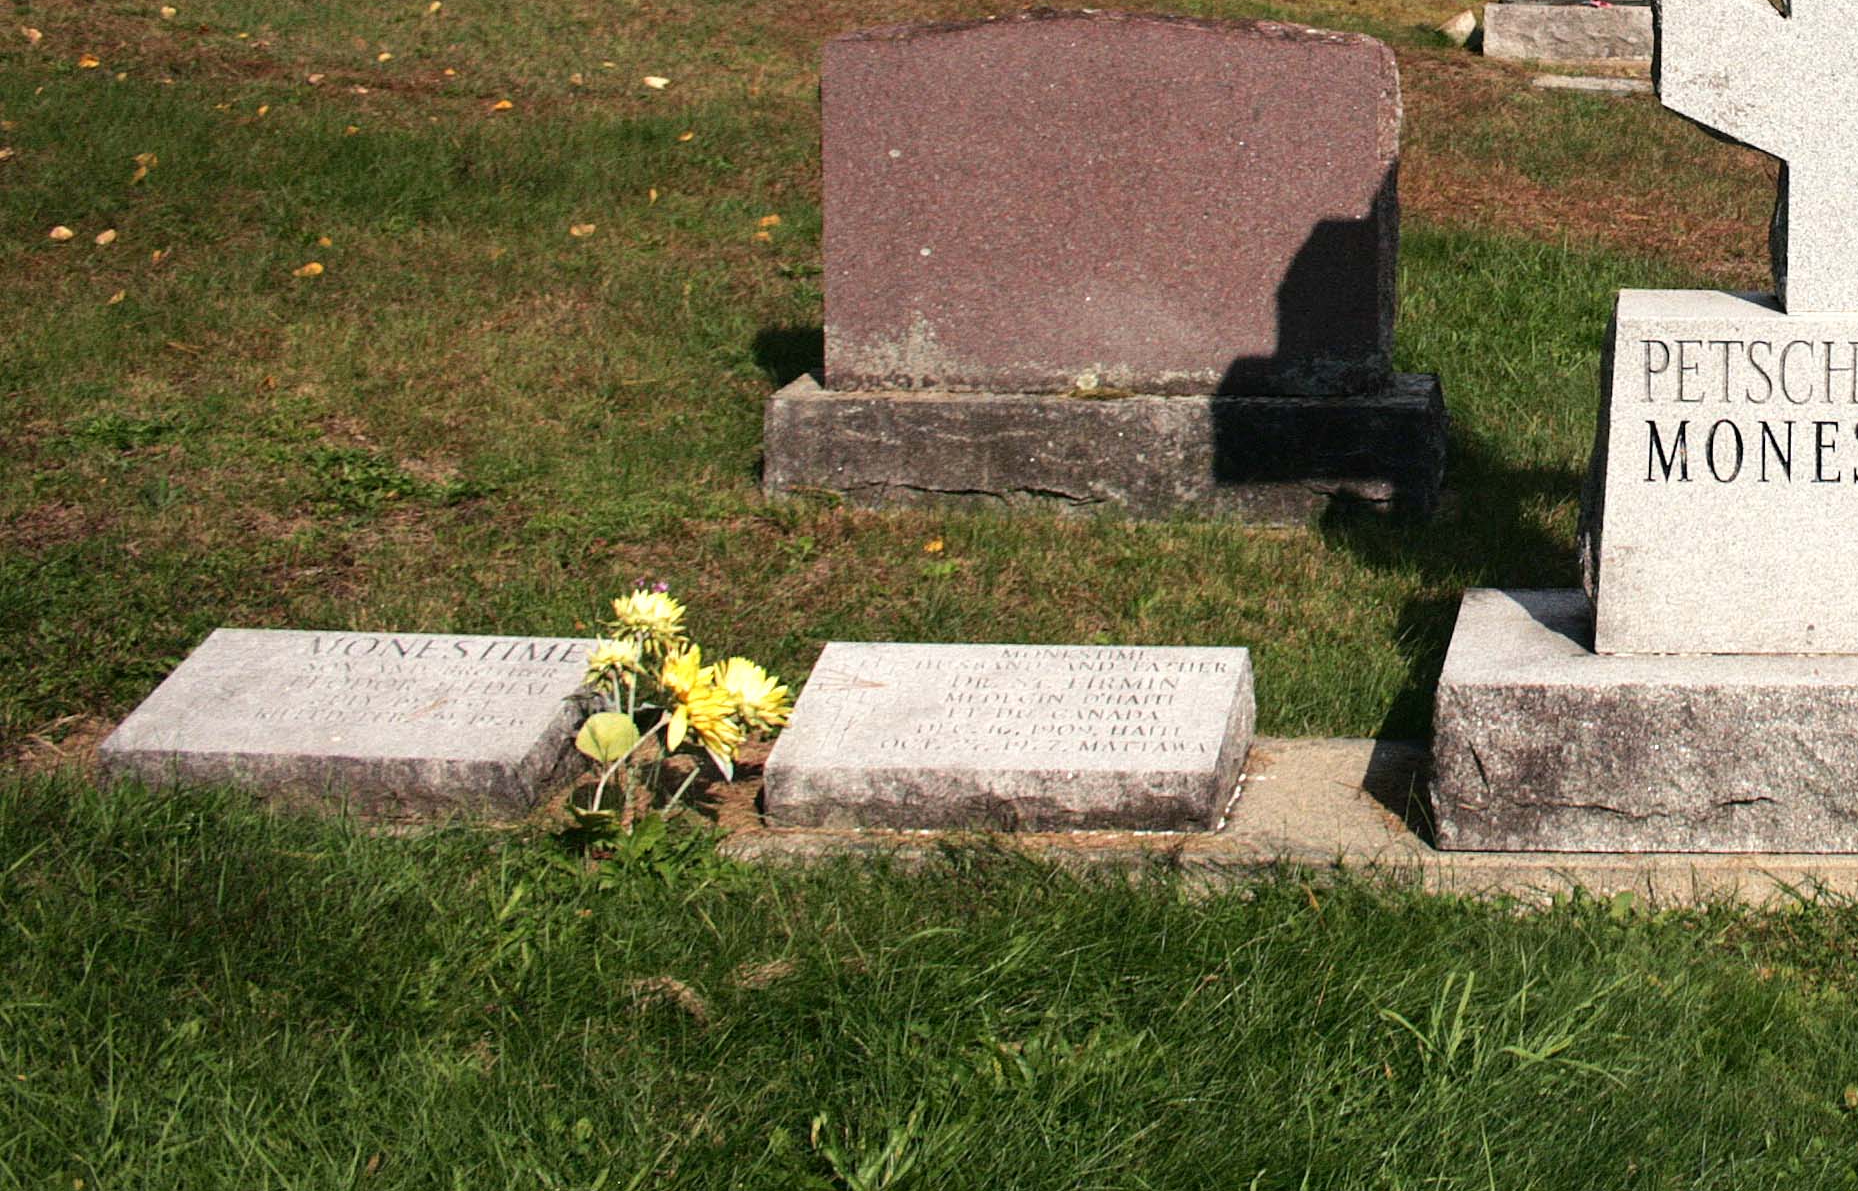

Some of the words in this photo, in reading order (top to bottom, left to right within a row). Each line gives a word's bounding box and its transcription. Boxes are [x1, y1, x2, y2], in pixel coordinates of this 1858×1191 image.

[305, 636, 586, 664] MONESTIME
[1001, 648, 1148, 660] MONESTIME
[915, 659, 1043, 671] HUSBAND
[1067, 661, 1116, 672] AND
[1132, 661, 1229, 673] FATHER
[1066, 676, 1181, 691] FIRMIN
[1050, 708, 1161, 721] CANADA
[1077, 740, 1208, 753] MATTAWA
